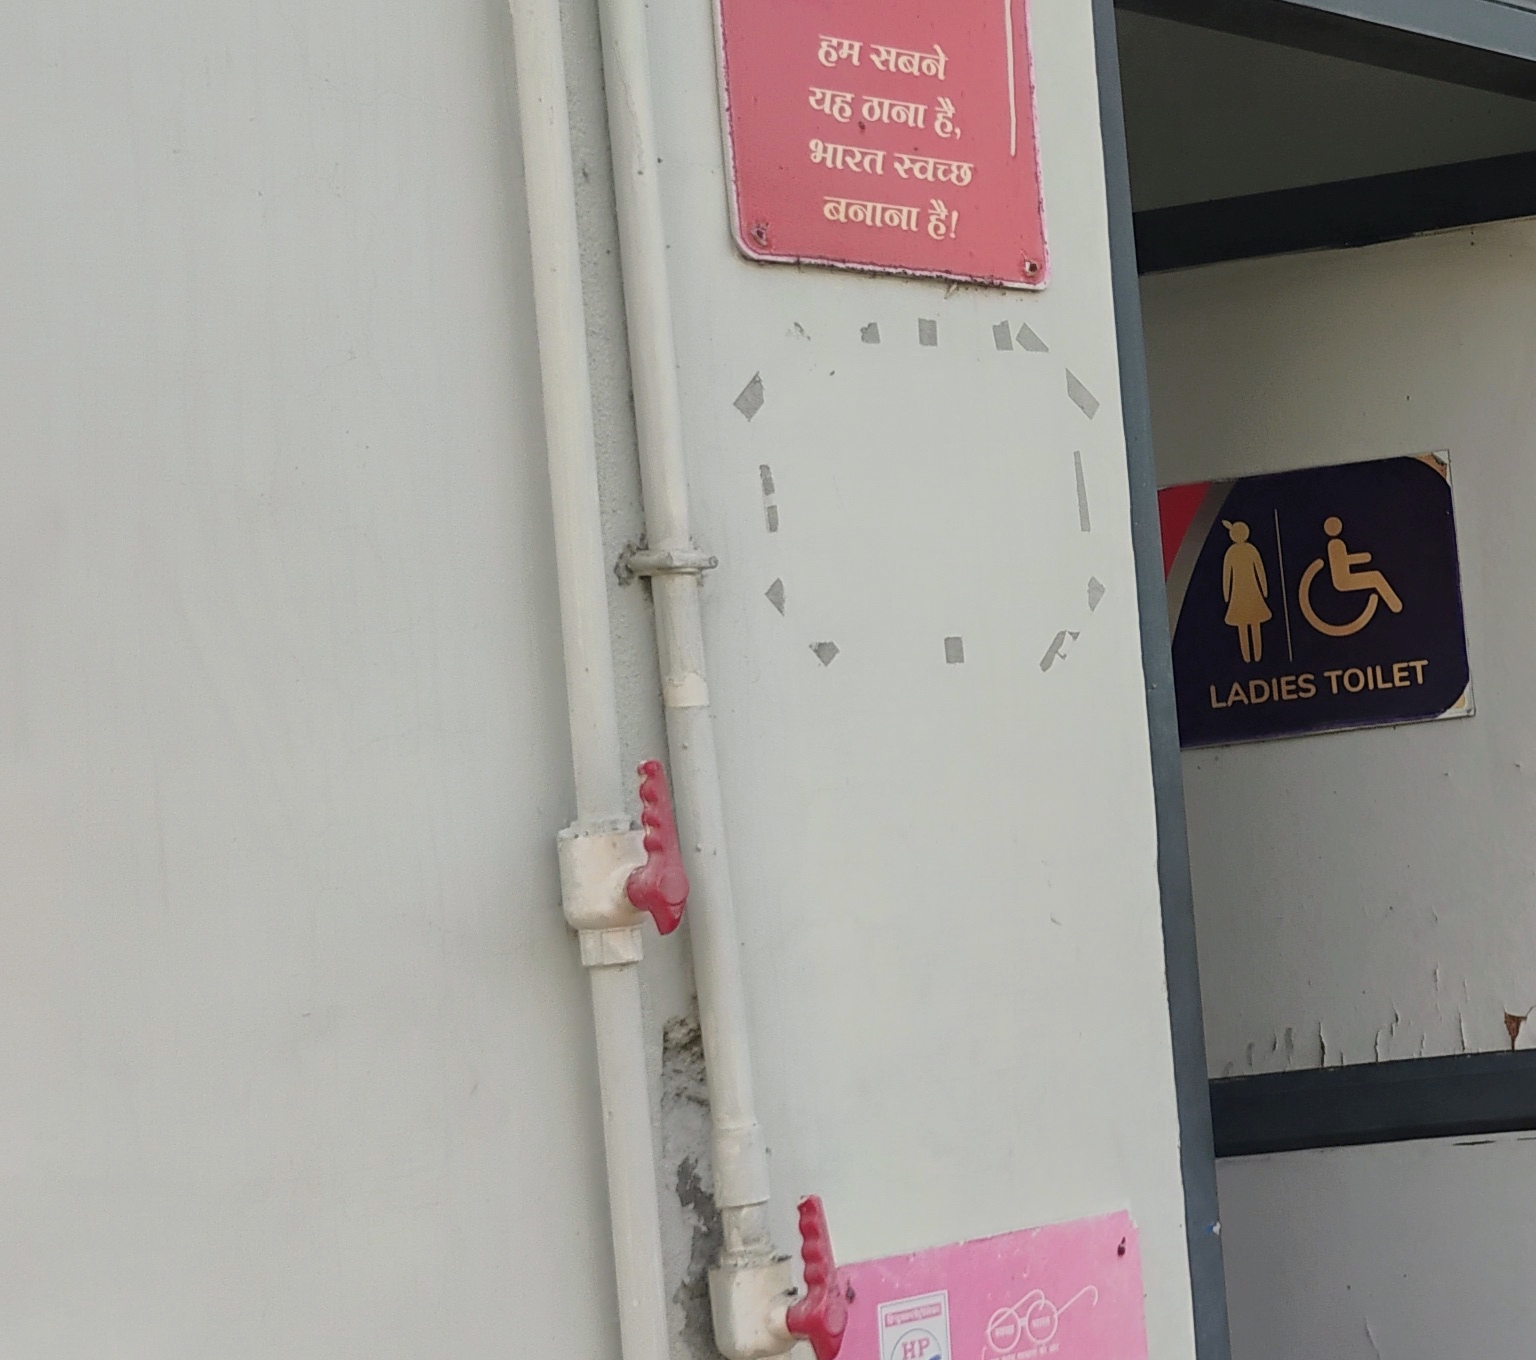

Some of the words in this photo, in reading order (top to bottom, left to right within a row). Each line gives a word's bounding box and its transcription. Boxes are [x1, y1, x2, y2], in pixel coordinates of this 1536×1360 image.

[817, 34, 860, 67] हम
[870, 42, 948, 80] सबने
[808, 87, 853, 122] यह
[862, 96, 927, 129] ठाना
[934, 97, 962, 139] है,
[808, 138, 885, 175] भारत
[893, 152, 974, 187] स्वच्छ
[822, 196, 920, 232] बनाना
[926, 198, 960, 240] है!
[1210, 674, 1316, 710] LADIES
[1323, 659, 1429, 695] TOILET
[902, 1337, 930, 1360] HP
